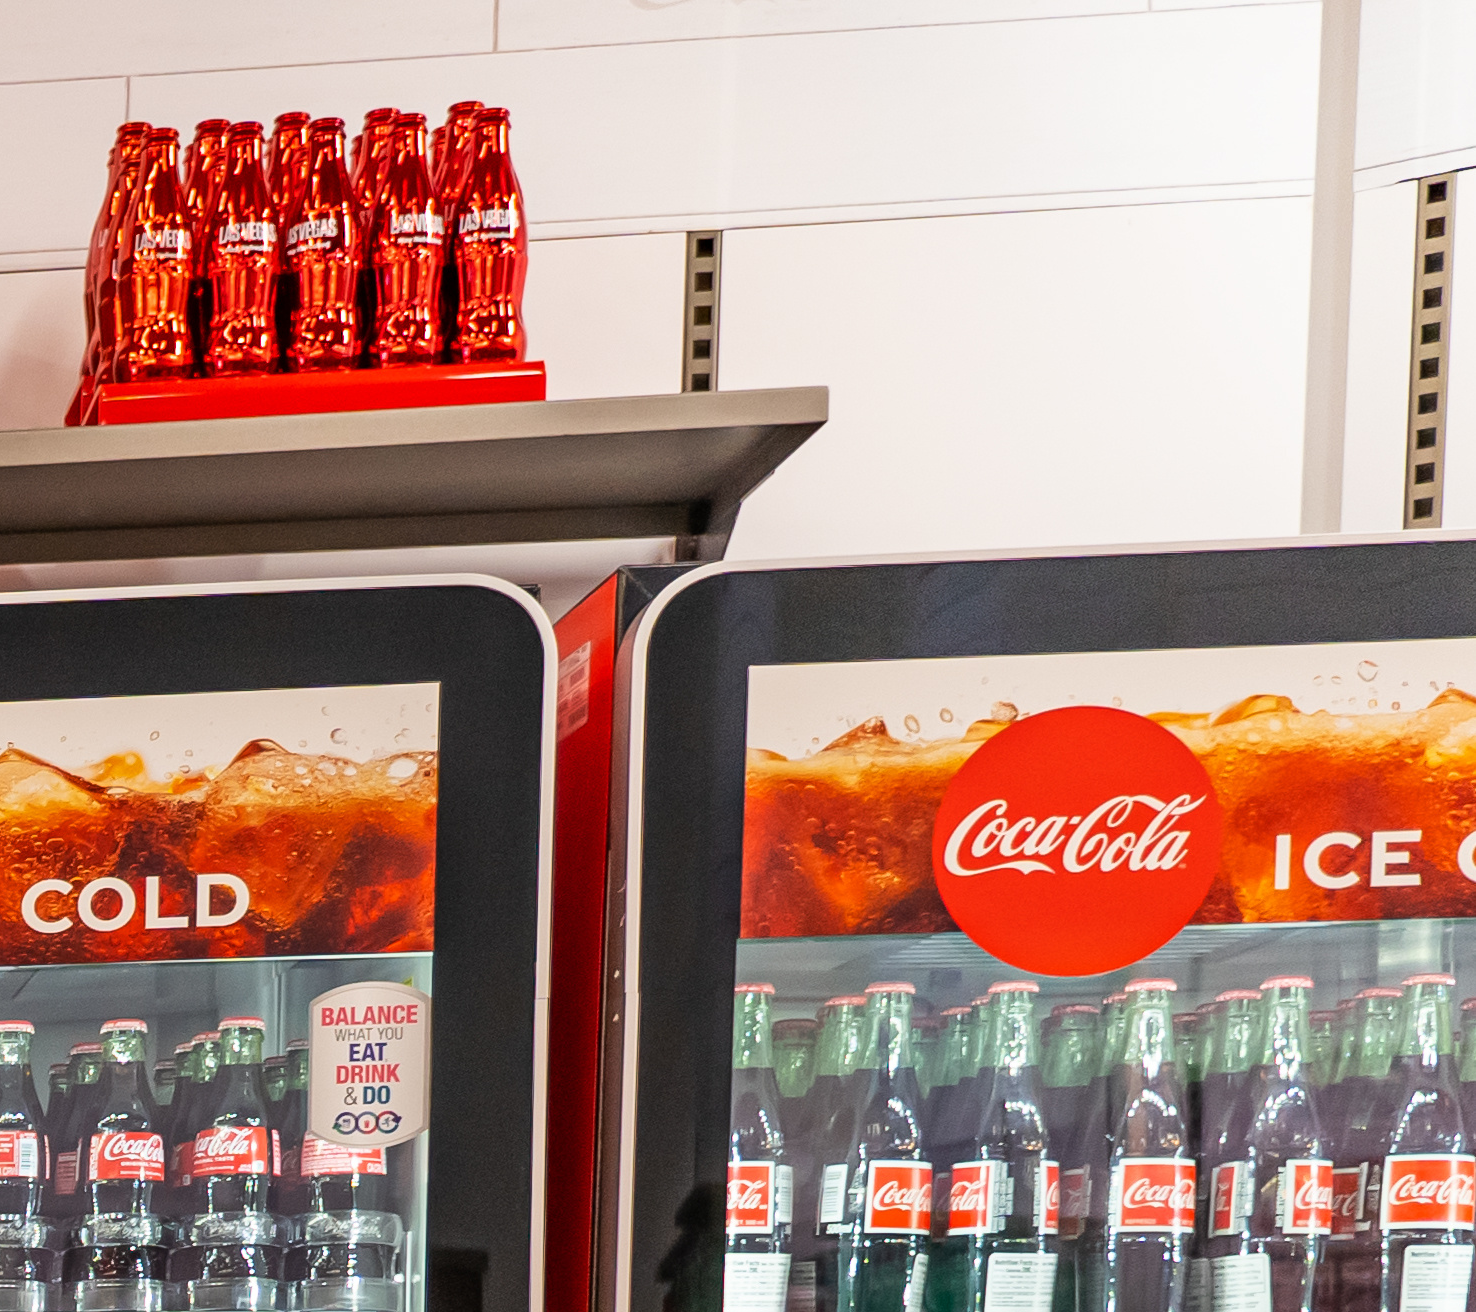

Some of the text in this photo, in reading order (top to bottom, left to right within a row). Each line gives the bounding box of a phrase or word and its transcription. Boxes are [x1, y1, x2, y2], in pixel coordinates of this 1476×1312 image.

[943, 794, 1207, 877] Coca-Cola
[1274, 830, 1423, 890] ICE
[20, 873, 250, 934] COLD
[320, 1005, 419, 1027] BALANCE
[334, 1026, 404, 1042] WHAT YOU
[335, 1064, 401, 1085] DRINK
[343, 1085, 391, 1106] & DO
